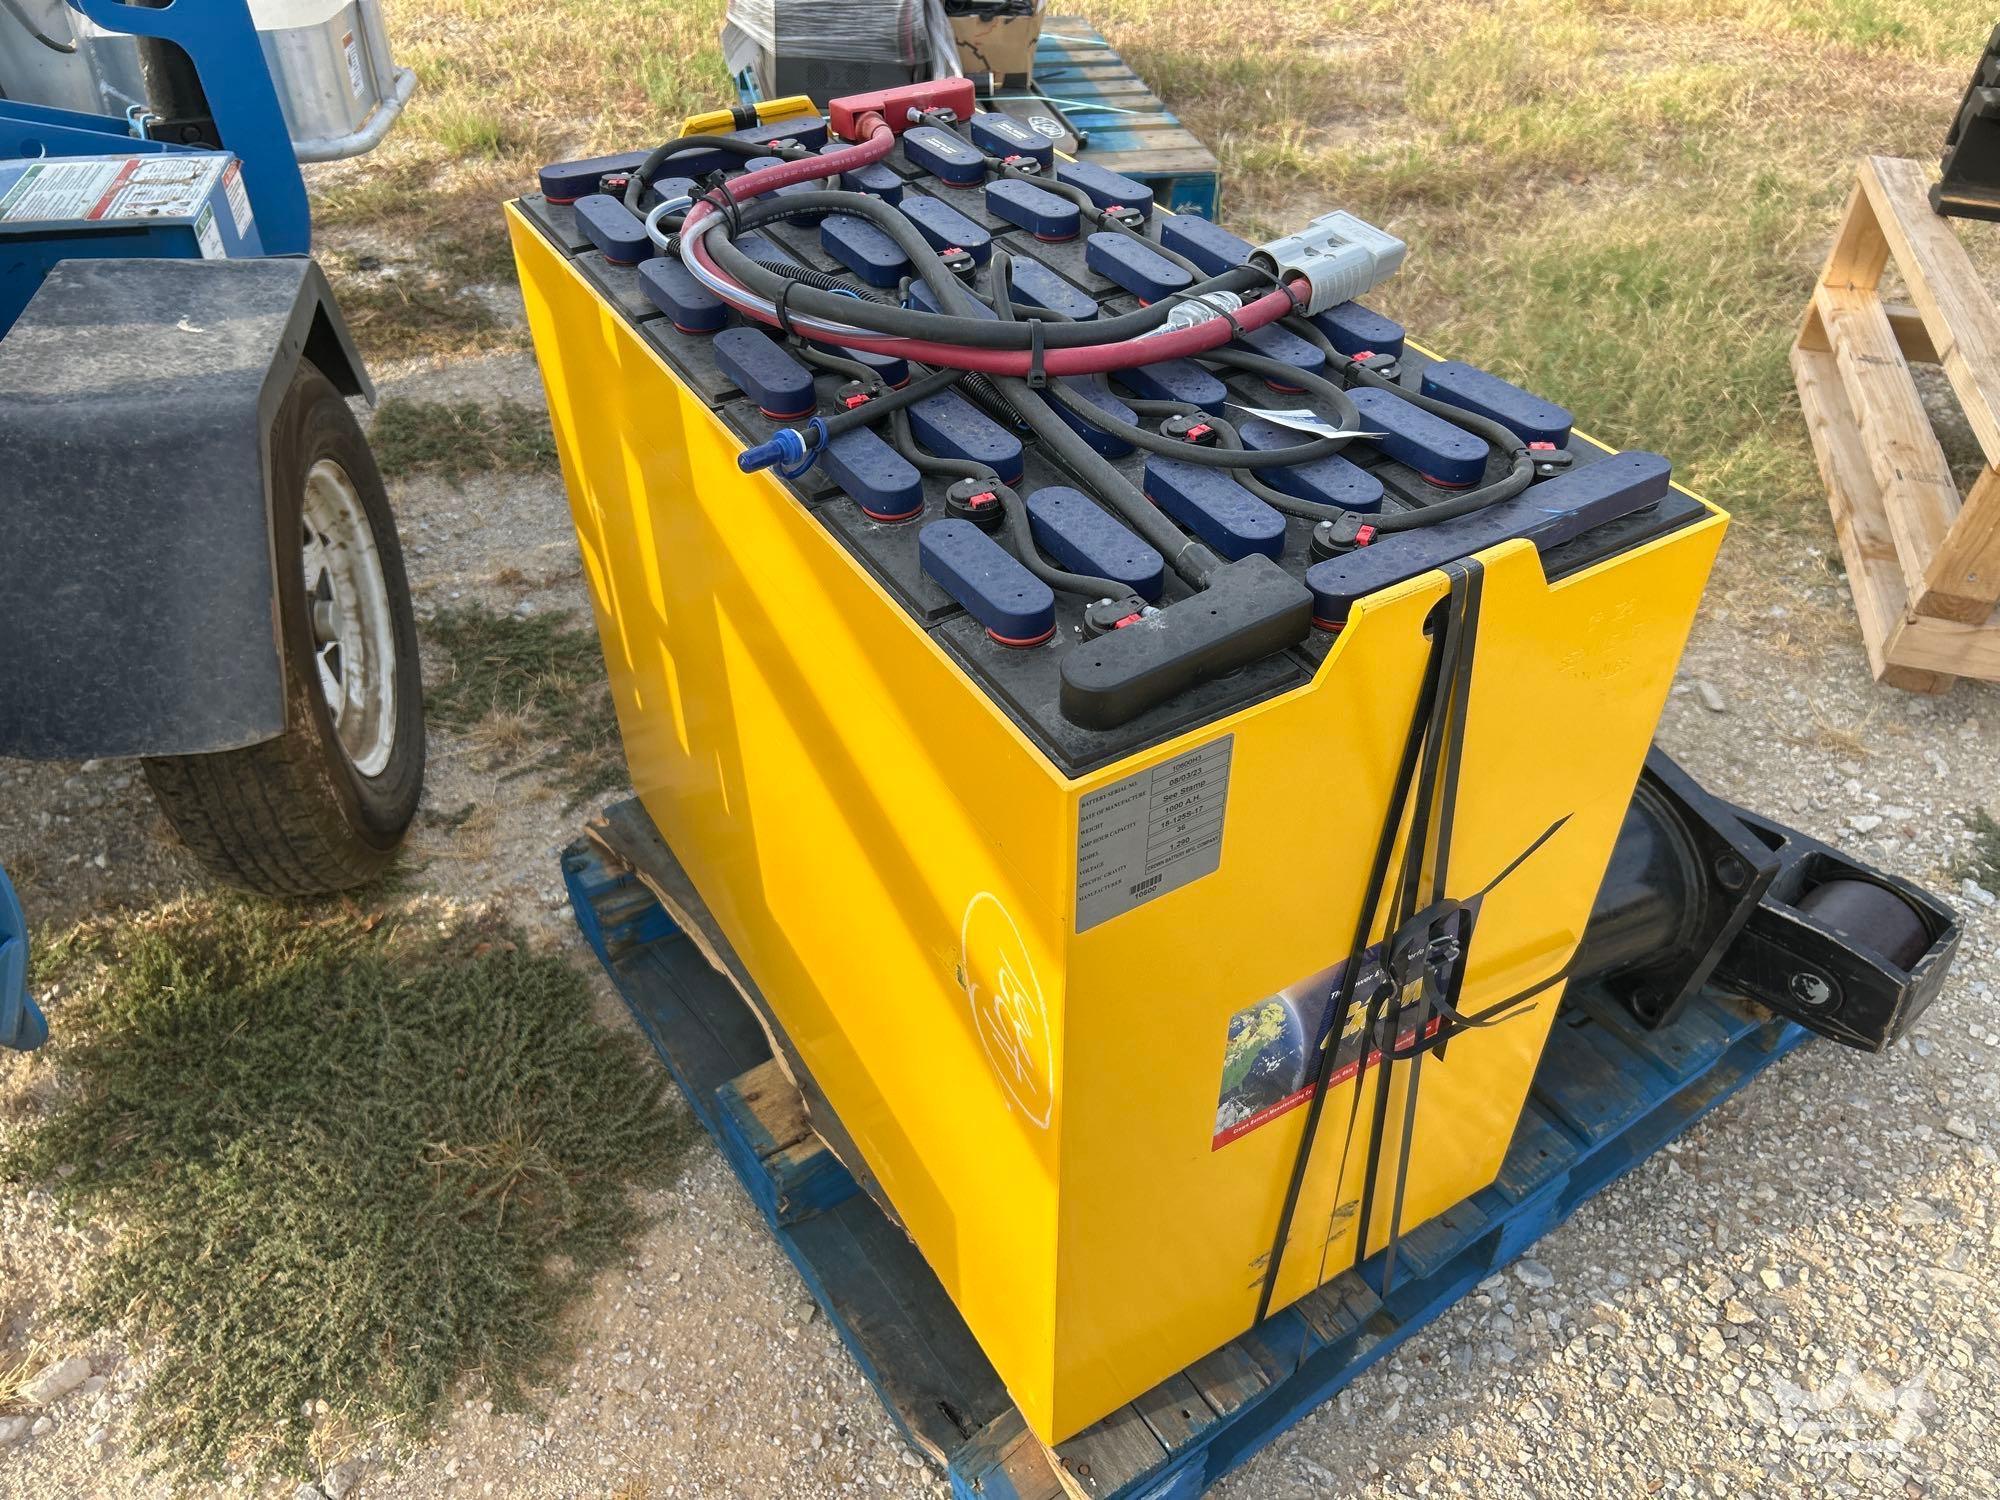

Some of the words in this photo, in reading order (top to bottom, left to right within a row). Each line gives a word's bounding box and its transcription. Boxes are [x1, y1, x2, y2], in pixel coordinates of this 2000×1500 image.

[1081, 794, 1106, 809] BATTERY
[1108, 785, 1127, 797] SERIAL
[1163, 792, 1178, 802] See
[1180, 780, 1206, 795] Stamp
[1081, 812, 1096, 822] DATE
[1096, 808, 1105, 816] OF
[1105, 791, 1146, 811] MANUFACTURE
[1165, 801, 1184, 813] 1000
[1080, 822, 1103, 836] WEIGHT
[1109, 821, 1136, 837] CAPACITY
[1170, 837, 1190, 850] 1.290
[1080, 851, 1098, 862] MODEL
[1147, 860, 1164, 871] CROWN
[1164, 851, 1184, 863] BATTERY
[1197, 836, 1218, 849] COMPANY
[1080, 862, 1104, 875] VOLTAGE
[1103, 864, 1127, 877] GRAVITY
[1233, 1123, 1249, 1134] Crown
